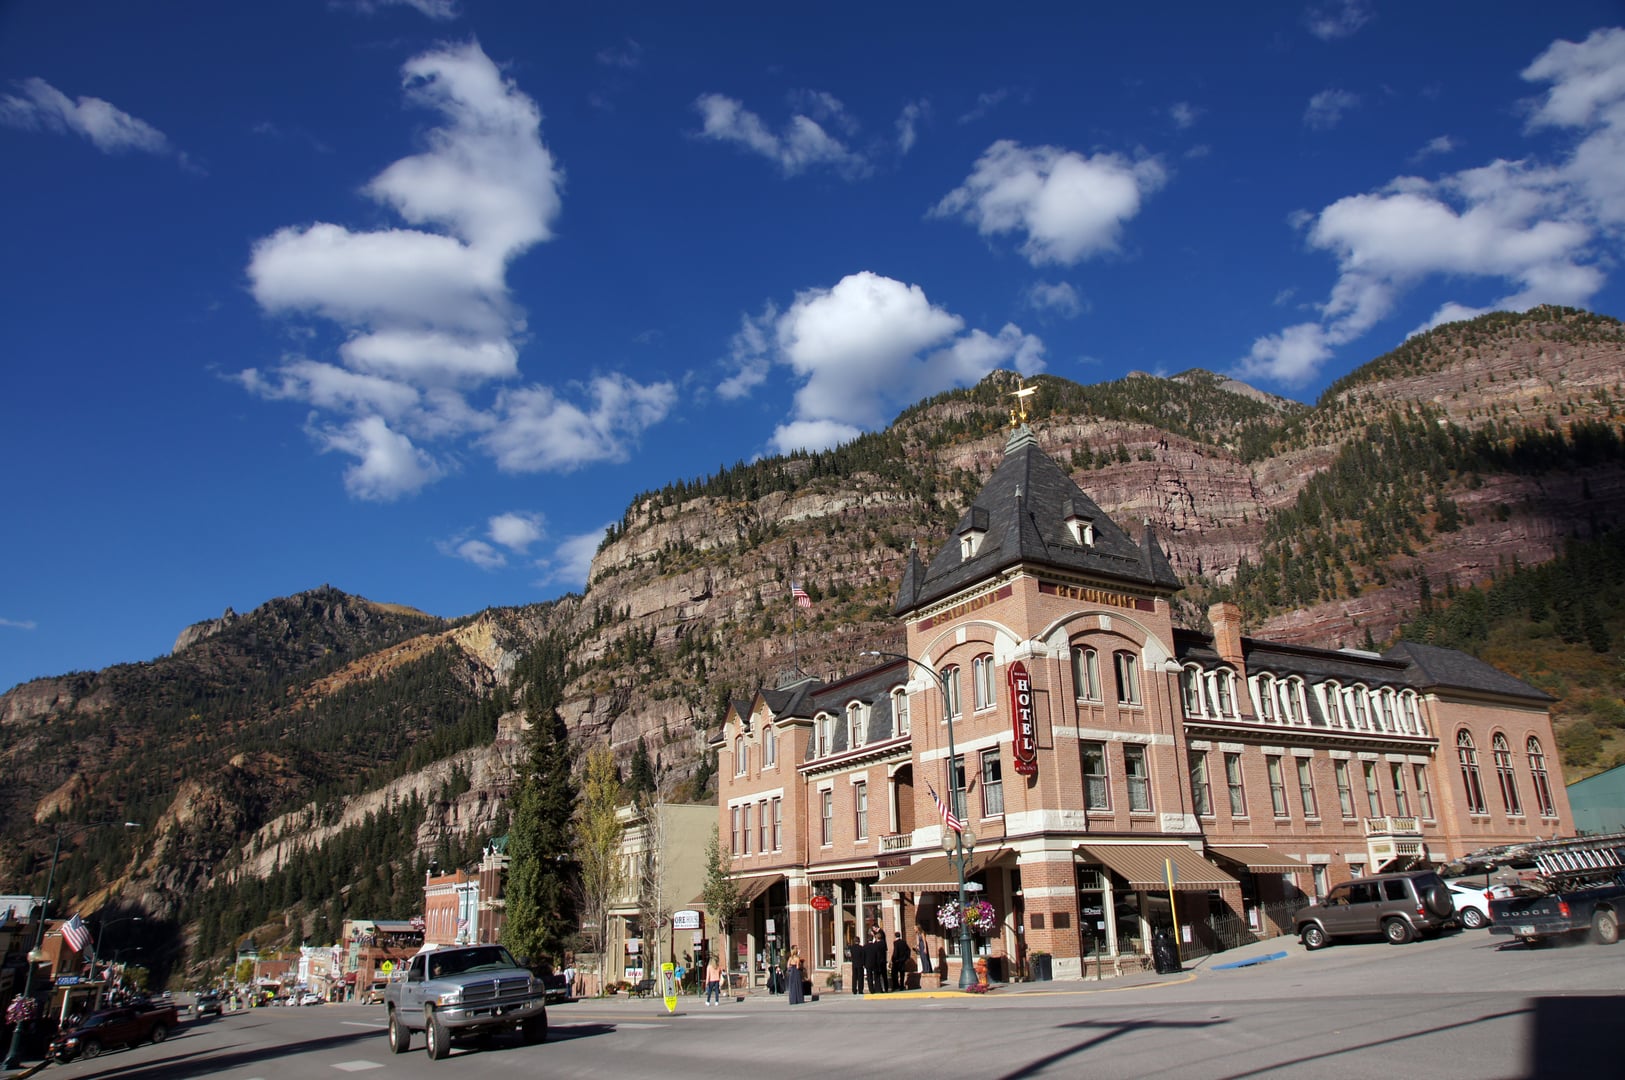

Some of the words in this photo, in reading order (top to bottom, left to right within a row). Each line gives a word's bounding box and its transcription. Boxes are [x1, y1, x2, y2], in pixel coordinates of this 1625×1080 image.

[932, 589, 999, 627] BEAUMONT
[1056, 585, 1136, 609] BEAUMONT
[1017, 679, 1032, 750] HOTEL
[674, 916, 686, 925] ORE
[1502, 908, 1550, 917] DODGE
